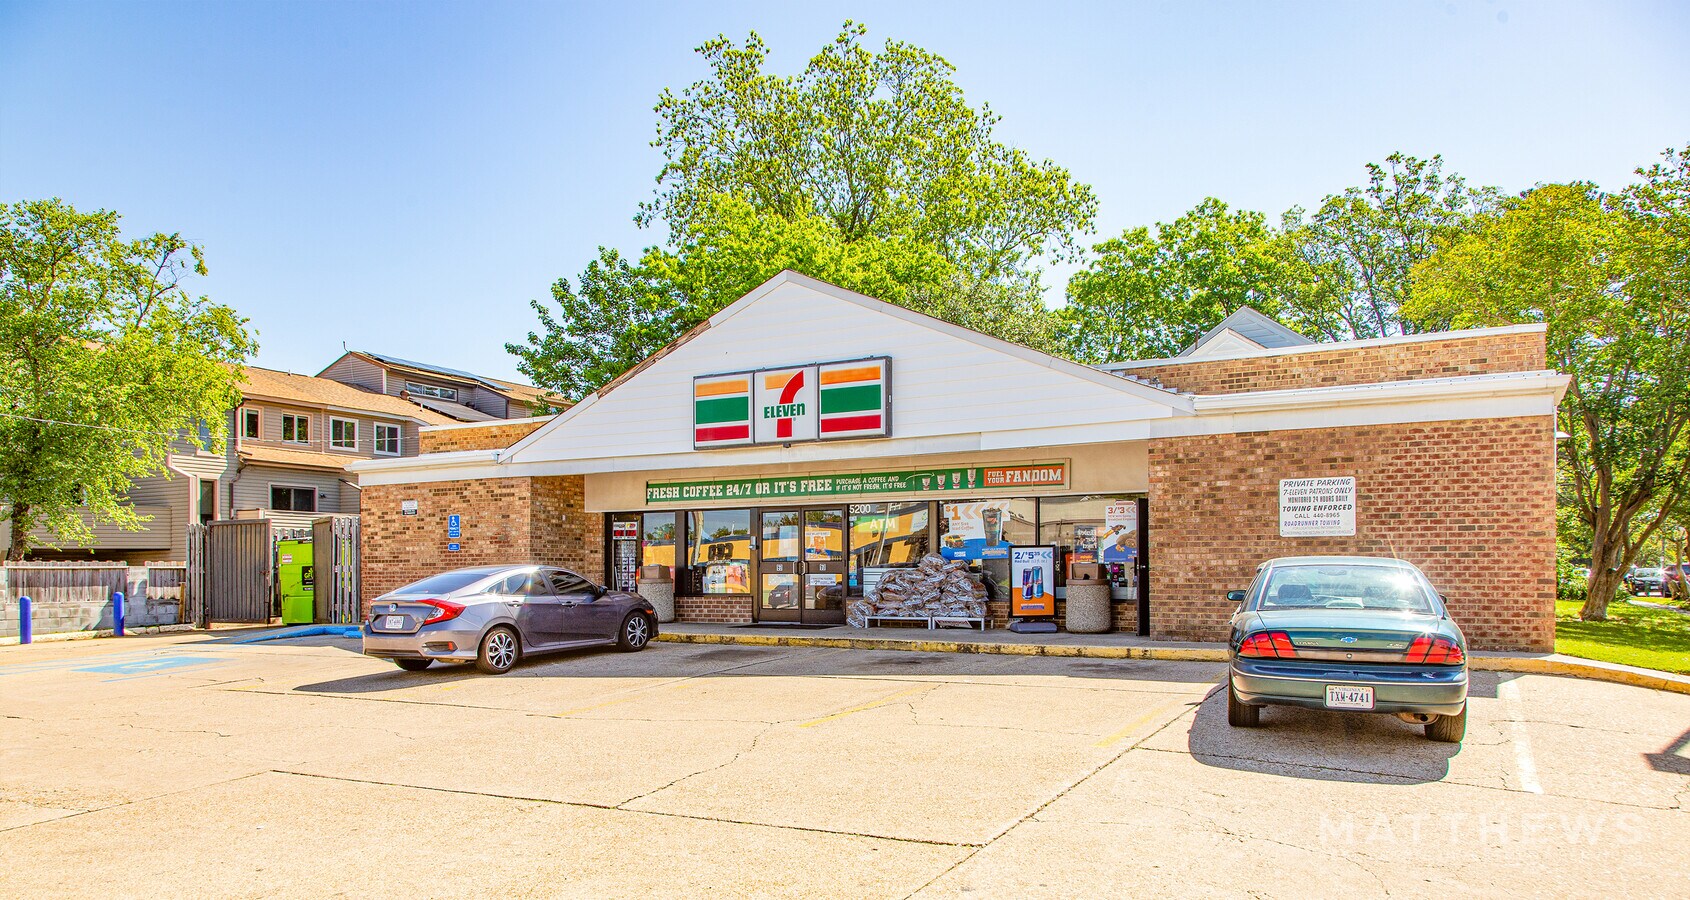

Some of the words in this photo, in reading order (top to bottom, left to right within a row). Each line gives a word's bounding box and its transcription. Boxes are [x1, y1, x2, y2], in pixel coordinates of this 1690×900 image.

[764, 369, 804, 438] 7
[836, 477, 861, 485] PURCHASE
[987, 470, 1004, 478] FUEL
[1006, 468, 1062, 483] FANDOM
[1317, 478, 1351, 486] PARKING
[646, 486, 680, 500] FRESH
[683, 484, 723, 499] COFFEE
[726, 483, 751, 496] 24/7
[755, 482, 770, 495] OR
[774, 480, 797, 494] IT'S
[800, 479, 832, 493] FREE
[852, 483, 862, 491] NOT
[894, 481, 907, 489] FREE
[849, 503, 871, 513] 5200
[946, 505, 961, 520] $1
[870, 516, 897, 530] ATM
